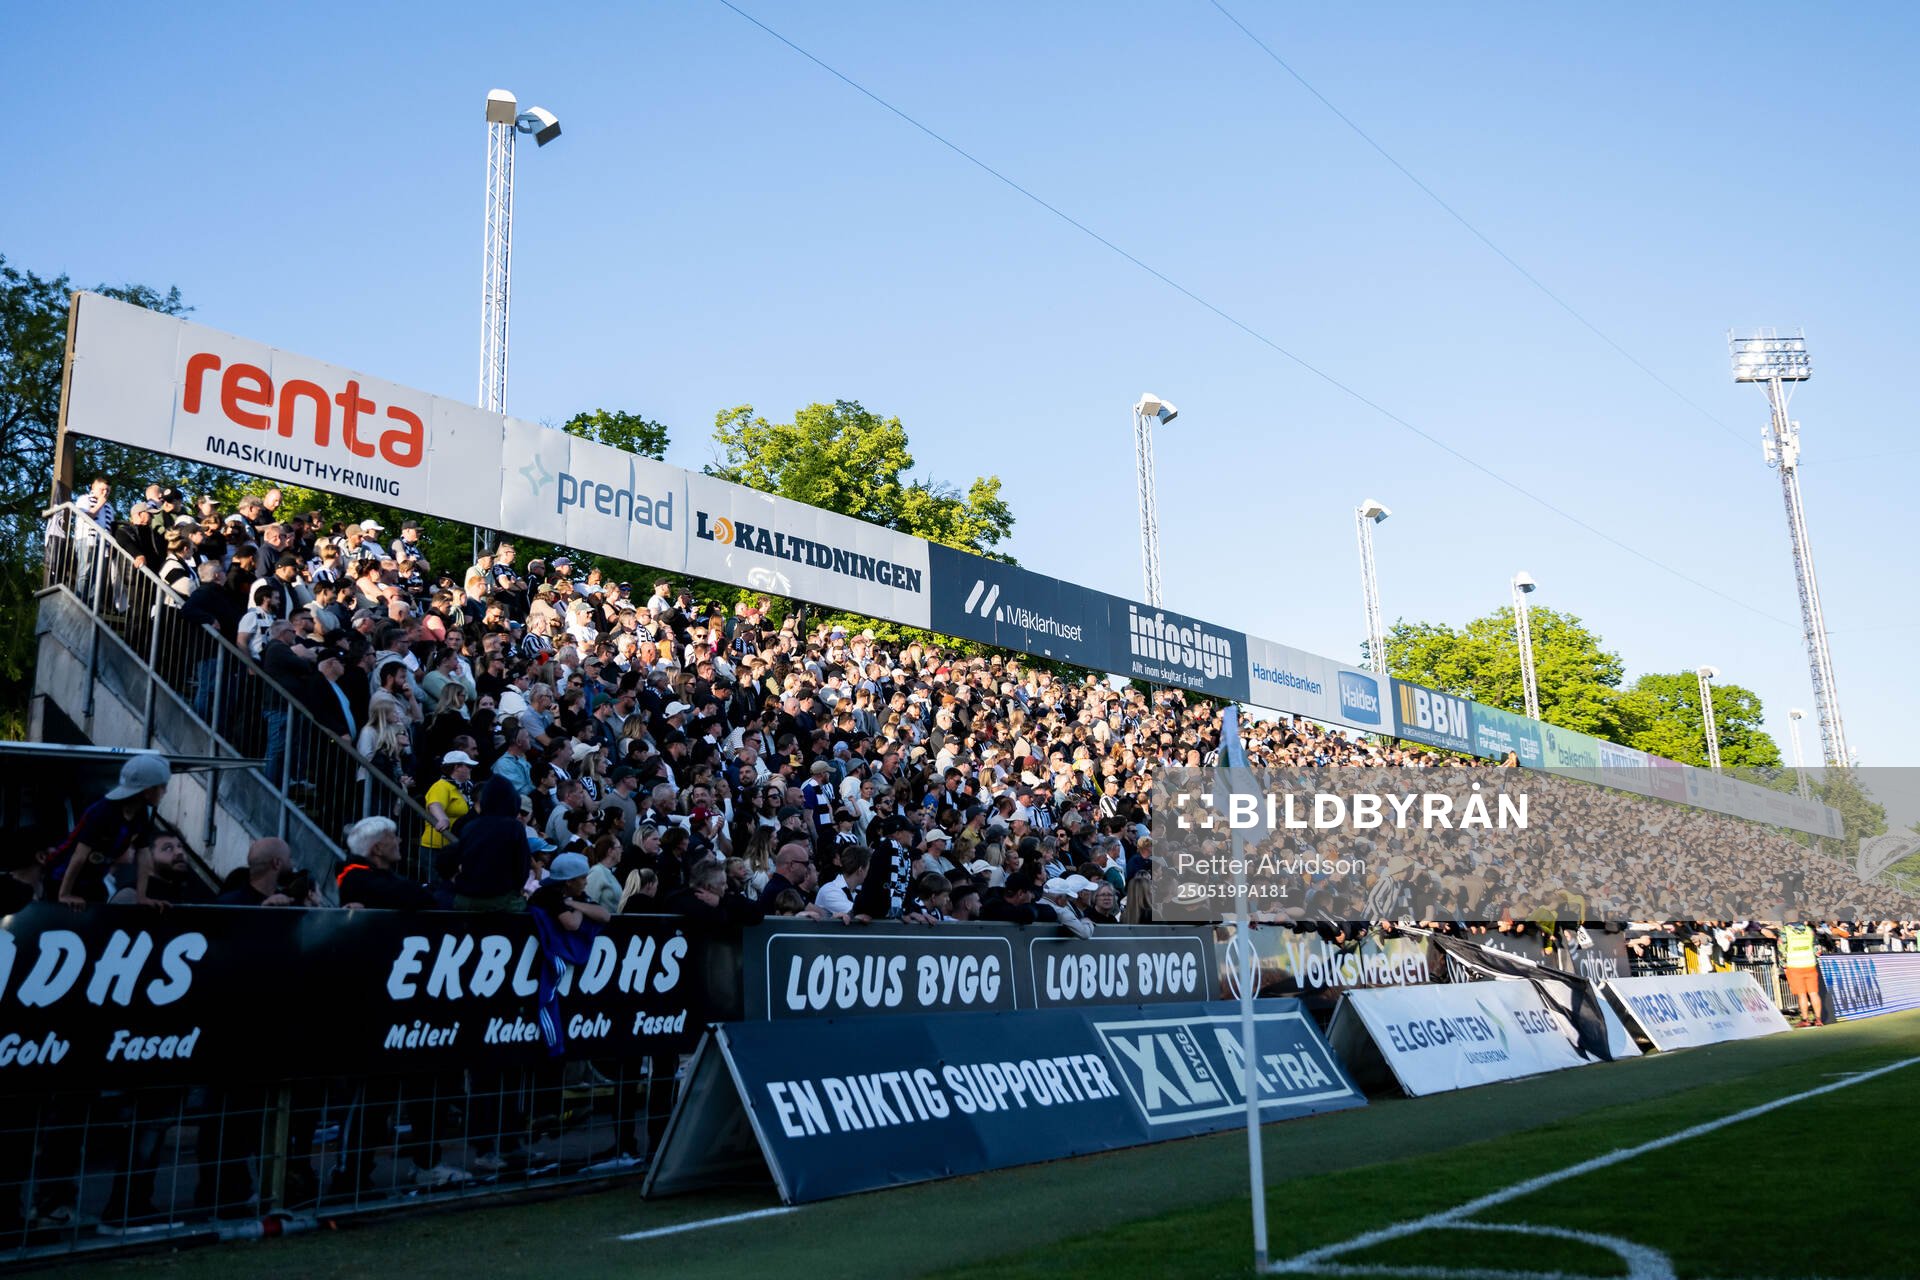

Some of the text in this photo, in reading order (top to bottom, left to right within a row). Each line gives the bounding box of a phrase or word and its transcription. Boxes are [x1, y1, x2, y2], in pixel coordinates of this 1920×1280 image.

[183, 352, 424, 468] renta
[206, 435, 400, 497] MASKINUTHYRNING
[557, 471, 673, 532] prenad
[696, 511, 922, 593] LOKALTIDNINGEN
[1007, 605, 1083, 642] Mäklarhuset
[1129, 605, 1233, 680] infosign
[1132, 660, 1144, 675] Allt
[1144, 664, 1160, 678] inom
[1160, 668, 1182, 684] skyltar
[1252, 662, 1322, 695] Handelsbanken
[1342, 684, 1378, 713] Haldex
[1414, 687, 1469, 740] BBM
[386, 932, 689, 1001] EKBLDHS
[786, 953, 1001, 1010] LOBUS BYGG
[1046, 951, 1198, 1001] LOBUS BYGG
[1286, 939, 1431, 989] Volkswagen
[106, 1026, 201, 1062] Fasad
[384, 1019, 461, 1049] Måleri
[567, 1011, 612, 1040] Golv
[632, 1008, 688, 1036] Fasad
[1385, 1015, 1495, 1053] ELGIGANTEN
[1109, 1033, 1224, 1110] XL
[1175, 1032, 1211, 1080] BYGG
[1464, 1049, 1511, 1065] LANDSKRONA
[766, 1053, 1120, 1139] EN RIKTIG SUPPORTER
